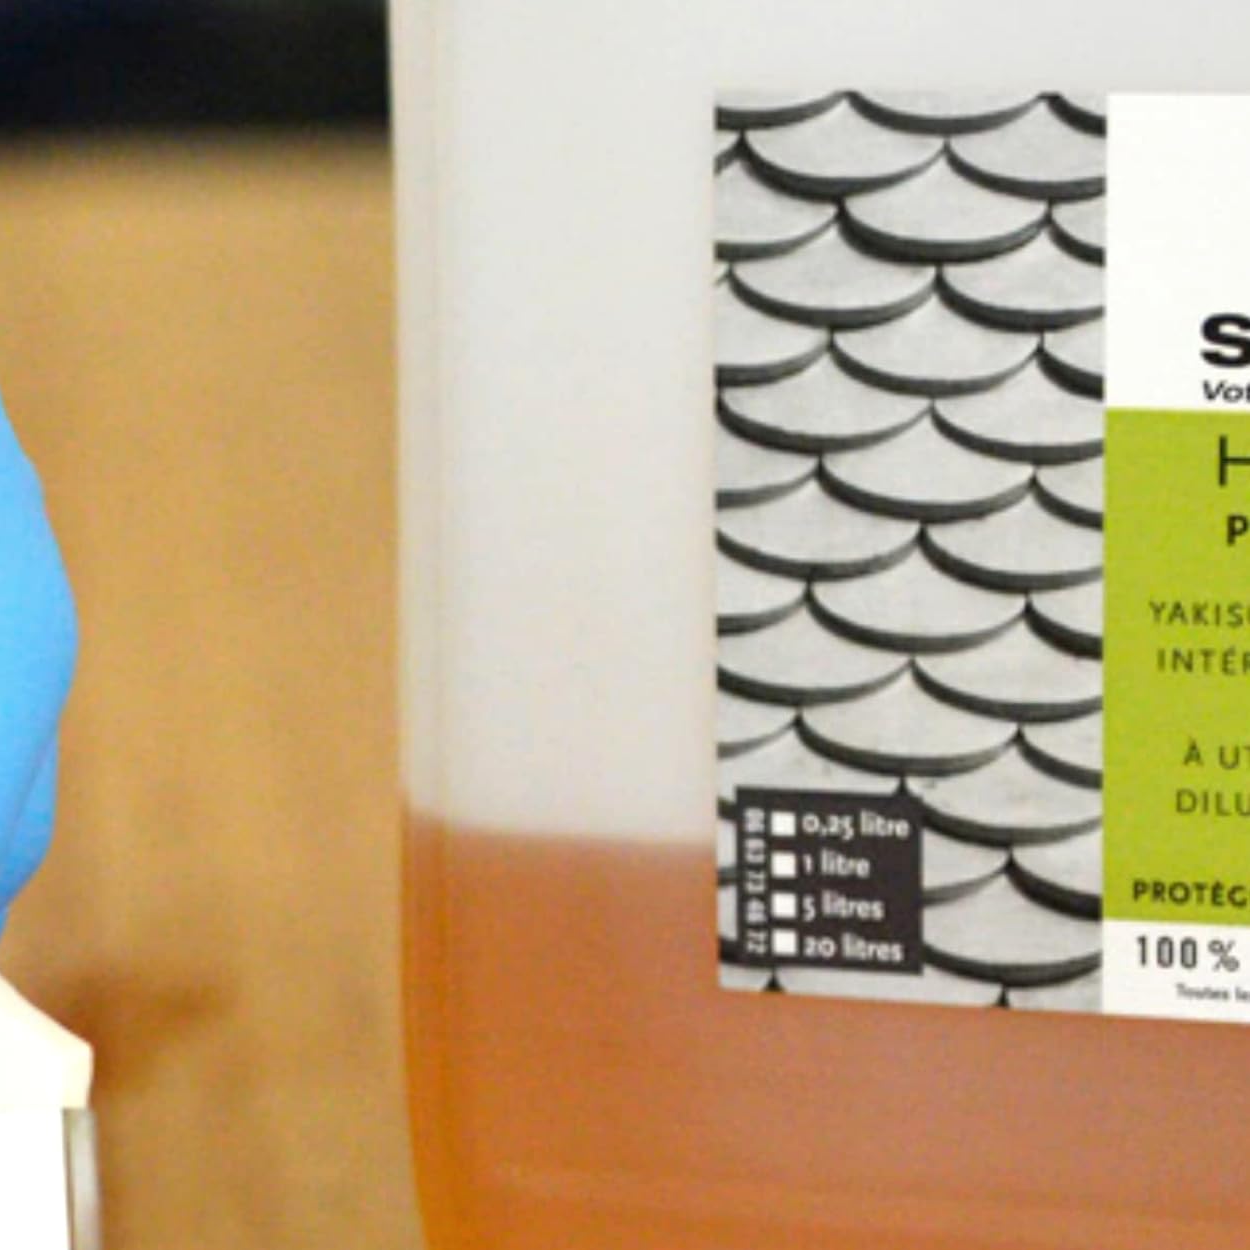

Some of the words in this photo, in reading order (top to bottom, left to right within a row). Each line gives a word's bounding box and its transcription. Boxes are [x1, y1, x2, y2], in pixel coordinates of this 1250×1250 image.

[1203, 380, 1250, 403] Vo
[1148, 600, 1250, 629] YAKIS
[802, 814, 854, 840] 0,25
[859, 809, 910, 840] litre
[802, 853, 813, 874] 1
[820, 848, 871, 879] litre
[802, 894, 816, 922] 5
[821, 889, 885, 922] litres
[802, 936, 836, 959] 20
[841, 931, 904, 962] litres
[1136, 934, 1198, 969] 100
[1207, 938, 1241, 973] %
